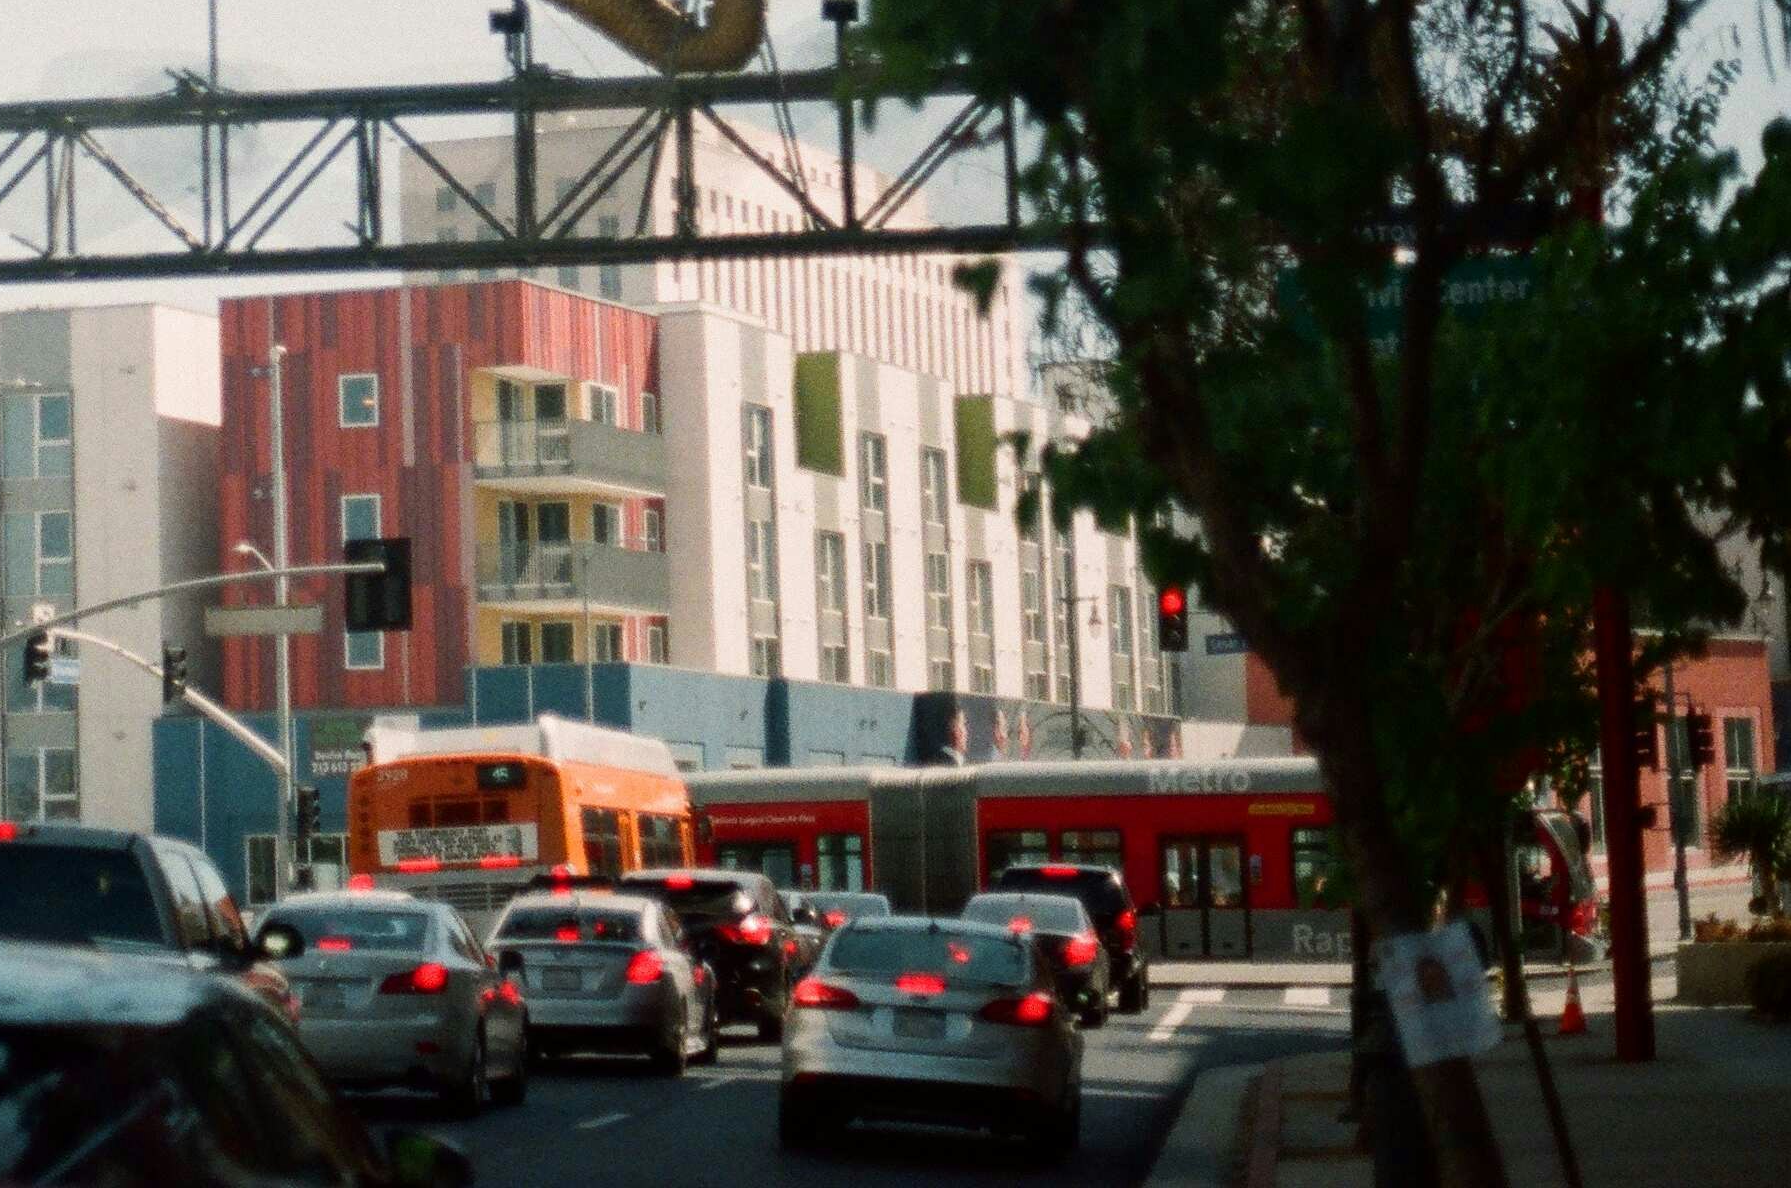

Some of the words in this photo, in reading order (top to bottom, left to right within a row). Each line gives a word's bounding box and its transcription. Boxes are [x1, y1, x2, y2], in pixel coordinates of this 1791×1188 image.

[1438, 274, 1531, 307] enter
[1148, 766, 1251, 794] Metro
[1291, 923, 1352, 957] Rap
